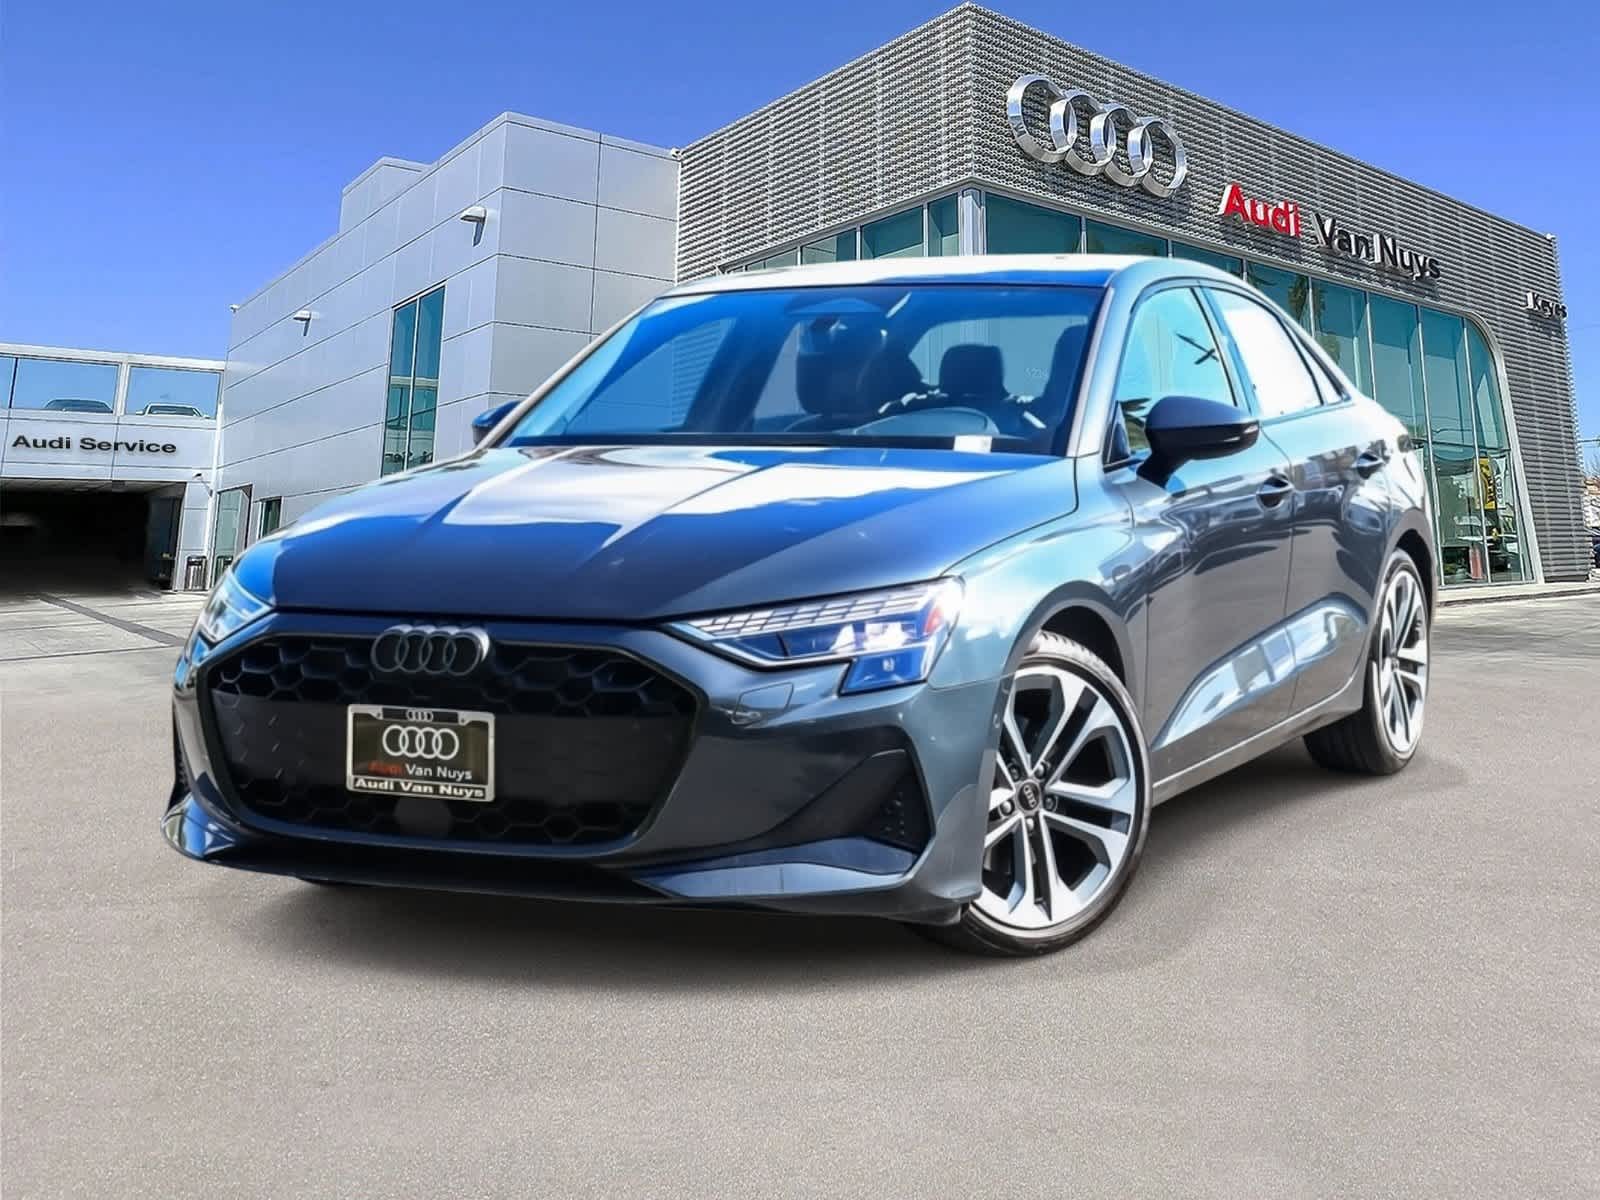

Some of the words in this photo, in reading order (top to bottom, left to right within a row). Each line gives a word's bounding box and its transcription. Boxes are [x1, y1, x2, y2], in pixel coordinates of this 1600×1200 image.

[1217, 181, 1301, 238] Audi
[1311, 213, 1370, 259] Van
[1373, 233, 1441, 280] Nuys
[12, 435, 71, 450] Audi
[79, 437, 177, 453] Service
[405, 763, 433, 777] Van
[437, 766, 472, 782] Nuys
[355, 778, 394, 790] Audi
[400, 781, 434, 793] Van
[439, 785, 484, 798] Nuys
